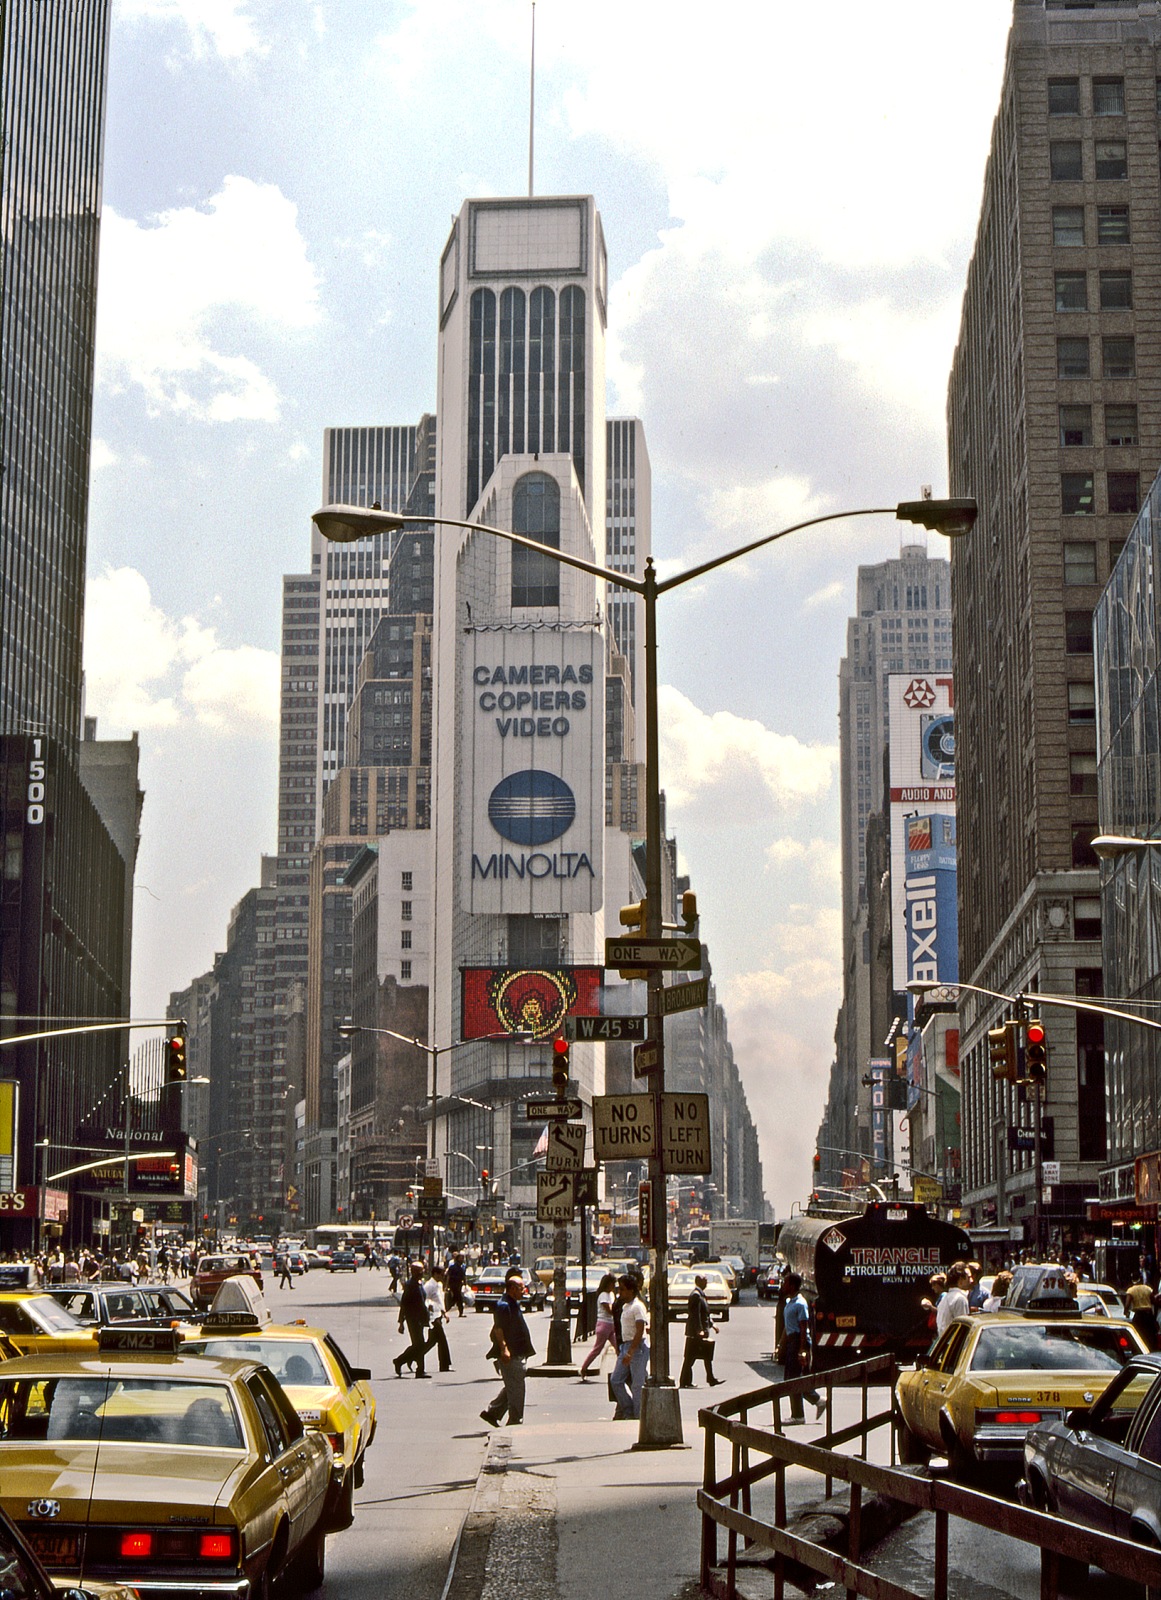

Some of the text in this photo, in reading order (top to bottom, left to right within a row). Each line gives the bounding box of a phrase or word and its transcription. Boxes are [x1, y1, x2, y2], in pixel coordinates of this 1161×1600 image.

[473, 665, 593, 685] CAMERAS
[479, 691, 586, 711] COPIERS
[496, 717, 570, 737] VIDEO
[27, 739, 45, 824] 1500
[901, 788, 953, 801] AUDIO AND
[471, 853, 594, 878] MINOLTA
[613, 947, 687, 960] ONE WAY
[666, 985, 705, 1011] BROADWAY
[581, 1020, 641, 1037] W 45 ST
[531, 1105, 574, 1115] ONE WAY
[612, 1103, 637, 1122] NO
[674, 1102, 697, 1120] NO
[105, 1128, 163, 1141] Naional
[566, 1127, 582, 1139] NO
[599, 1125, 651, 1144] TURNS
[669, 1127, 701, 1142] LEFT
[551, 1157, 580, 1168] TURN
[668, 1149, 704, 1164] TURN
[540, 1176, 556, 1187] NO
[541, 1205, 570, 1216] TURN
[850, 1247, 940, 1265] TRIANGLE
[845, 1265, 949, 1276] PETROLEUM TRANSPORT
[1042, 1277, 1064, 1290] 378
[118, 1334, 155, 1349] 2M23
[1037, 1391, 1060, 1402] 378
[169, 1515, 209, 1523] CHEVROLET
